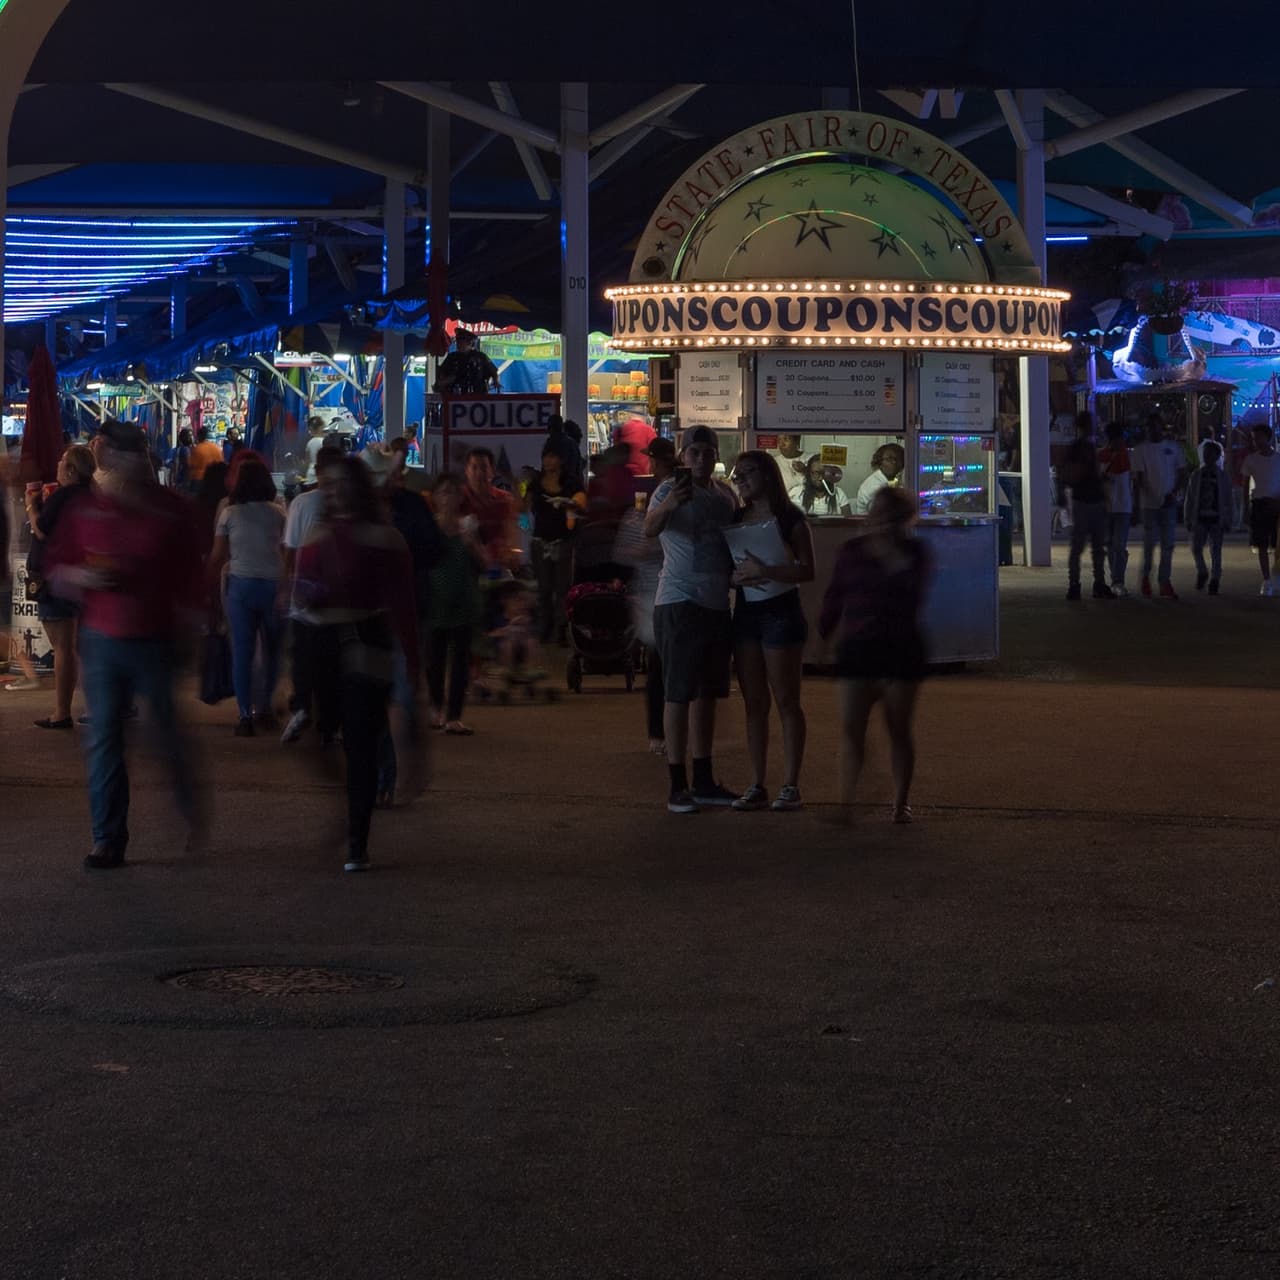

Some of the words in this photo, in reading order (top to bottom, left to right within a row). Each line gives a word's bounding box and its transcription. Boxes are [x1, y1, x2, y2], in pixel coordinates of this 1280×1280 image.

[655, 148, 745, 240] STATE
[757, 116, 843, 159] FAIR
[866, 122, 911, 158] OF
[929, 147, 1014, 240] TEXAS
[775, 359, 807, 368] CREDIT
[810, 359, 836, 368] CARD
[839, 359, 858, 368] AND
[860, 359, 886, 368] CASH
[451, 401, 553, 428] POLICE
